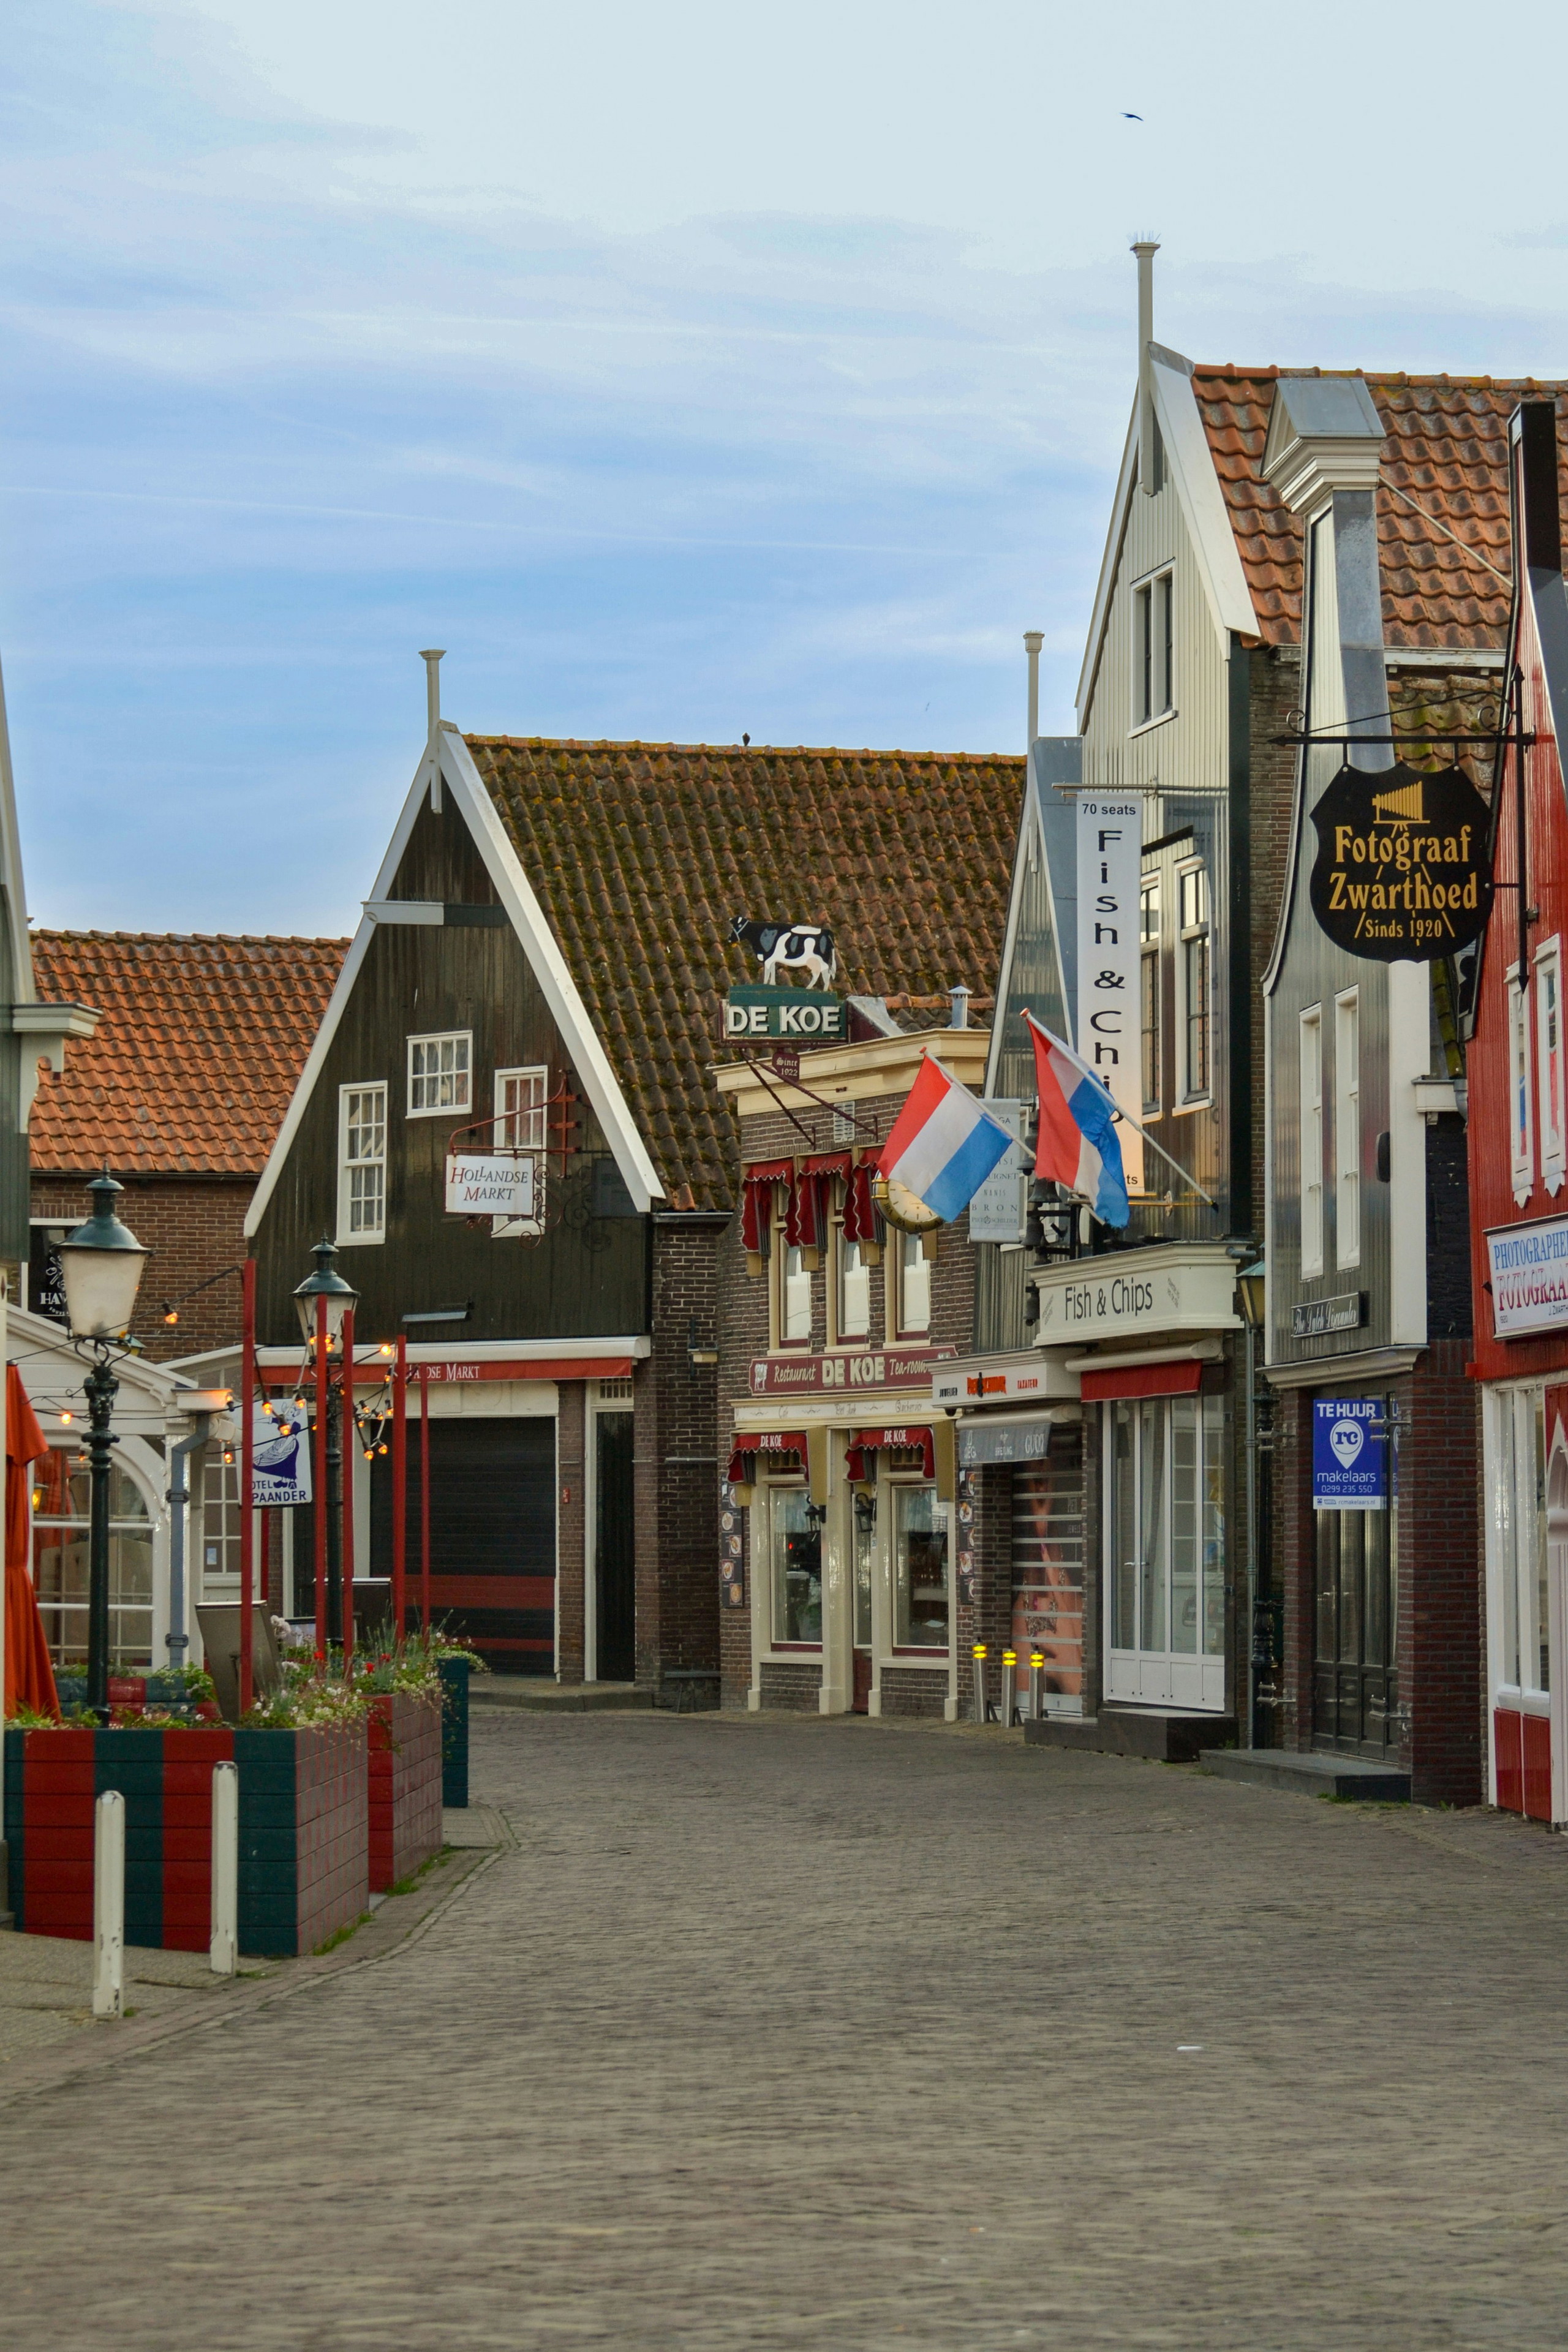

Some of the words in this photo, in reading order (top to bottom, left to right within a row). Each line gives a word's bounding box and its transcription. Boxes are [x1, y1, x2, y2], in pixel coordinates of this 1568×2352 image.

[1082, 804, 1097, 815] 70
[1101, 803, 1136, 815] seats
[1335, 825, 1471, 871] Fotograaf
[1095, 830, 1123, 944] Fish
[1329, 872, 1478, 910] Zwarthoed
[1365, 920, 1403, 938] Sinds
[1410, 920, 1442, 938] 1920
[1093, 970, 1126, 989] &
[728, 1005, 769, 1033] DE
[780, 1005, 841, 1033] KOE
[776, 1057, 798, 1066] Since
[781, 1068, 798, 1077] 1922
[450, 1166, 529, 1183] HOLLANDSE
[464, 1186, 515, 1201] MARKT
[1493, 1230, 1568, 1270] PHOTOGRAPHE
[1496, 1263, 1568, 1311] FOTOGRAA
[1065, 1284, 1091, 1321] Fish
[1097, 1288, 1107, 1316] &
[1111, 1277, 1153, 1316] Chips
[446, 1363, 480, 1381] MARKT
[774, 1363, 816, 1382] Restaurant
[822, 1359, 845, 1387] DE
[850, 1356, 886, 1386] KOE
[1017, 1378, 1038, 1389] TAXATEUR
[939, 1387, 958, 1398] JUWELIER
[1317, 1403, 1334, 1417] TE
[1336, 1403, 1376, 1417] HUUR
[760, 1436, 769, 1447] DE
[770, 1434, 782, 1447] KOE
[884, 1431, 892, 1442] DE
[894, 1430, 907, 1442] KOE
[1335, 1431, 1358, 1445] rc
[1317, 1471, 1376, 1482] makelaars
[252, 1480, 273, 1490] OTEL
[252, 1490, 306, 1503] PAANDER
